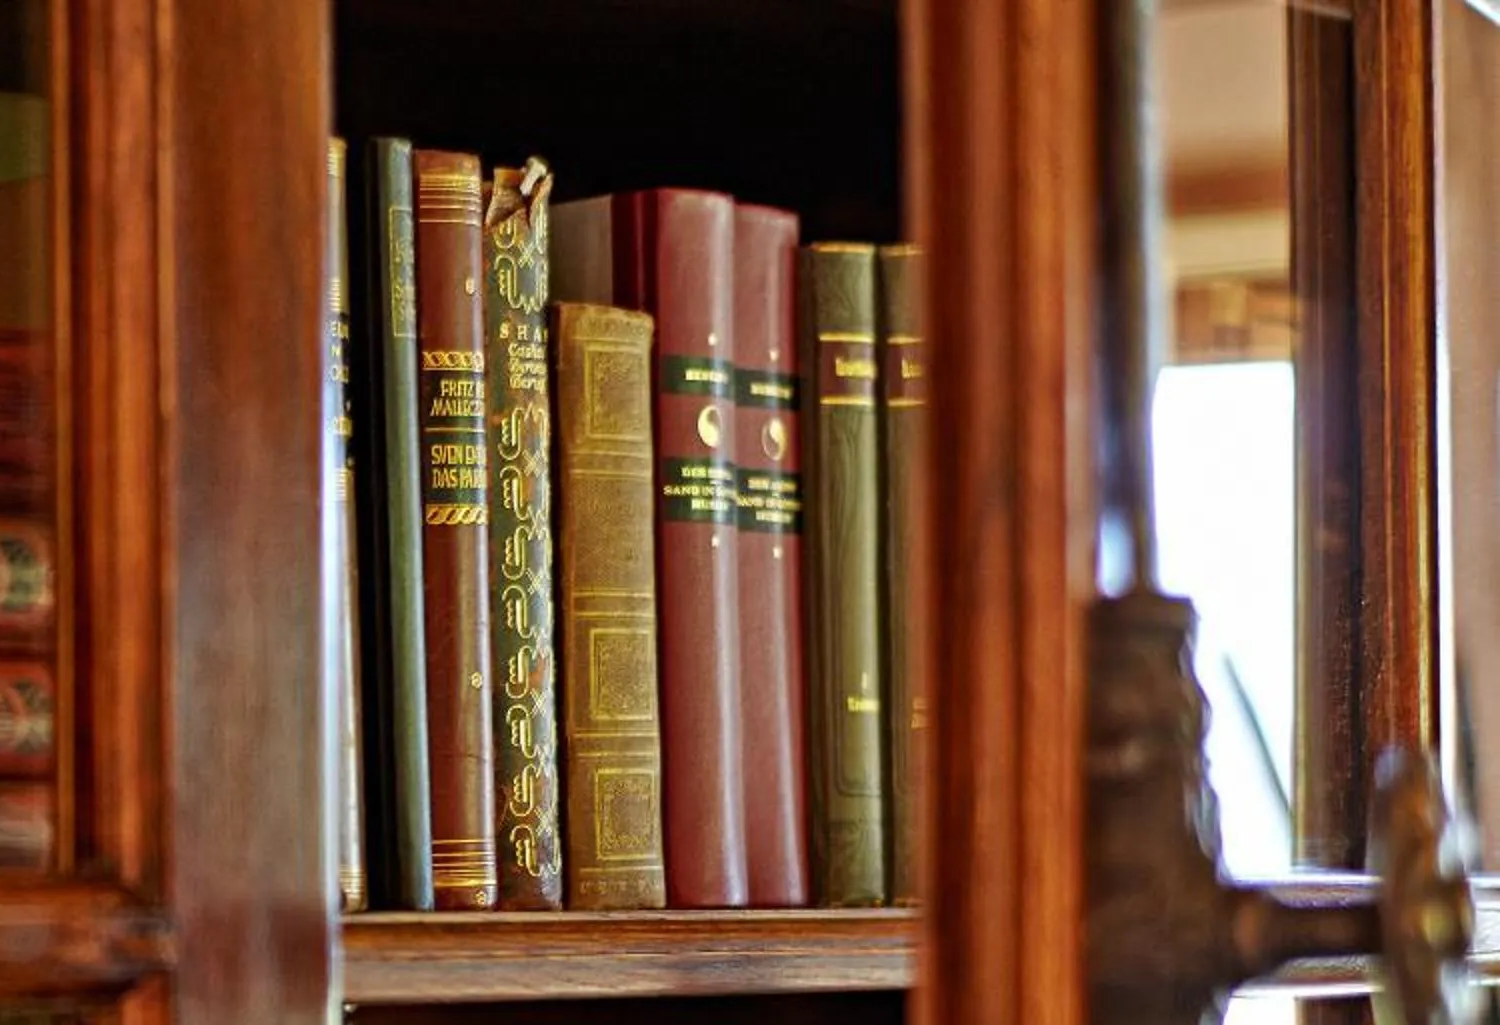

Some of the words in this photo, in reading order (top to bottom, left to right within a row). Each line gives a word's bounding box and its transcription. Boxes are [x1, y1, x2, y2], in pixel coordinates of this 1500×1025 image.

[441, 380, 474, 397] FRITZ
[431, 444, 463, 465] SVEN
[432, 467, 457, 489] DAS
